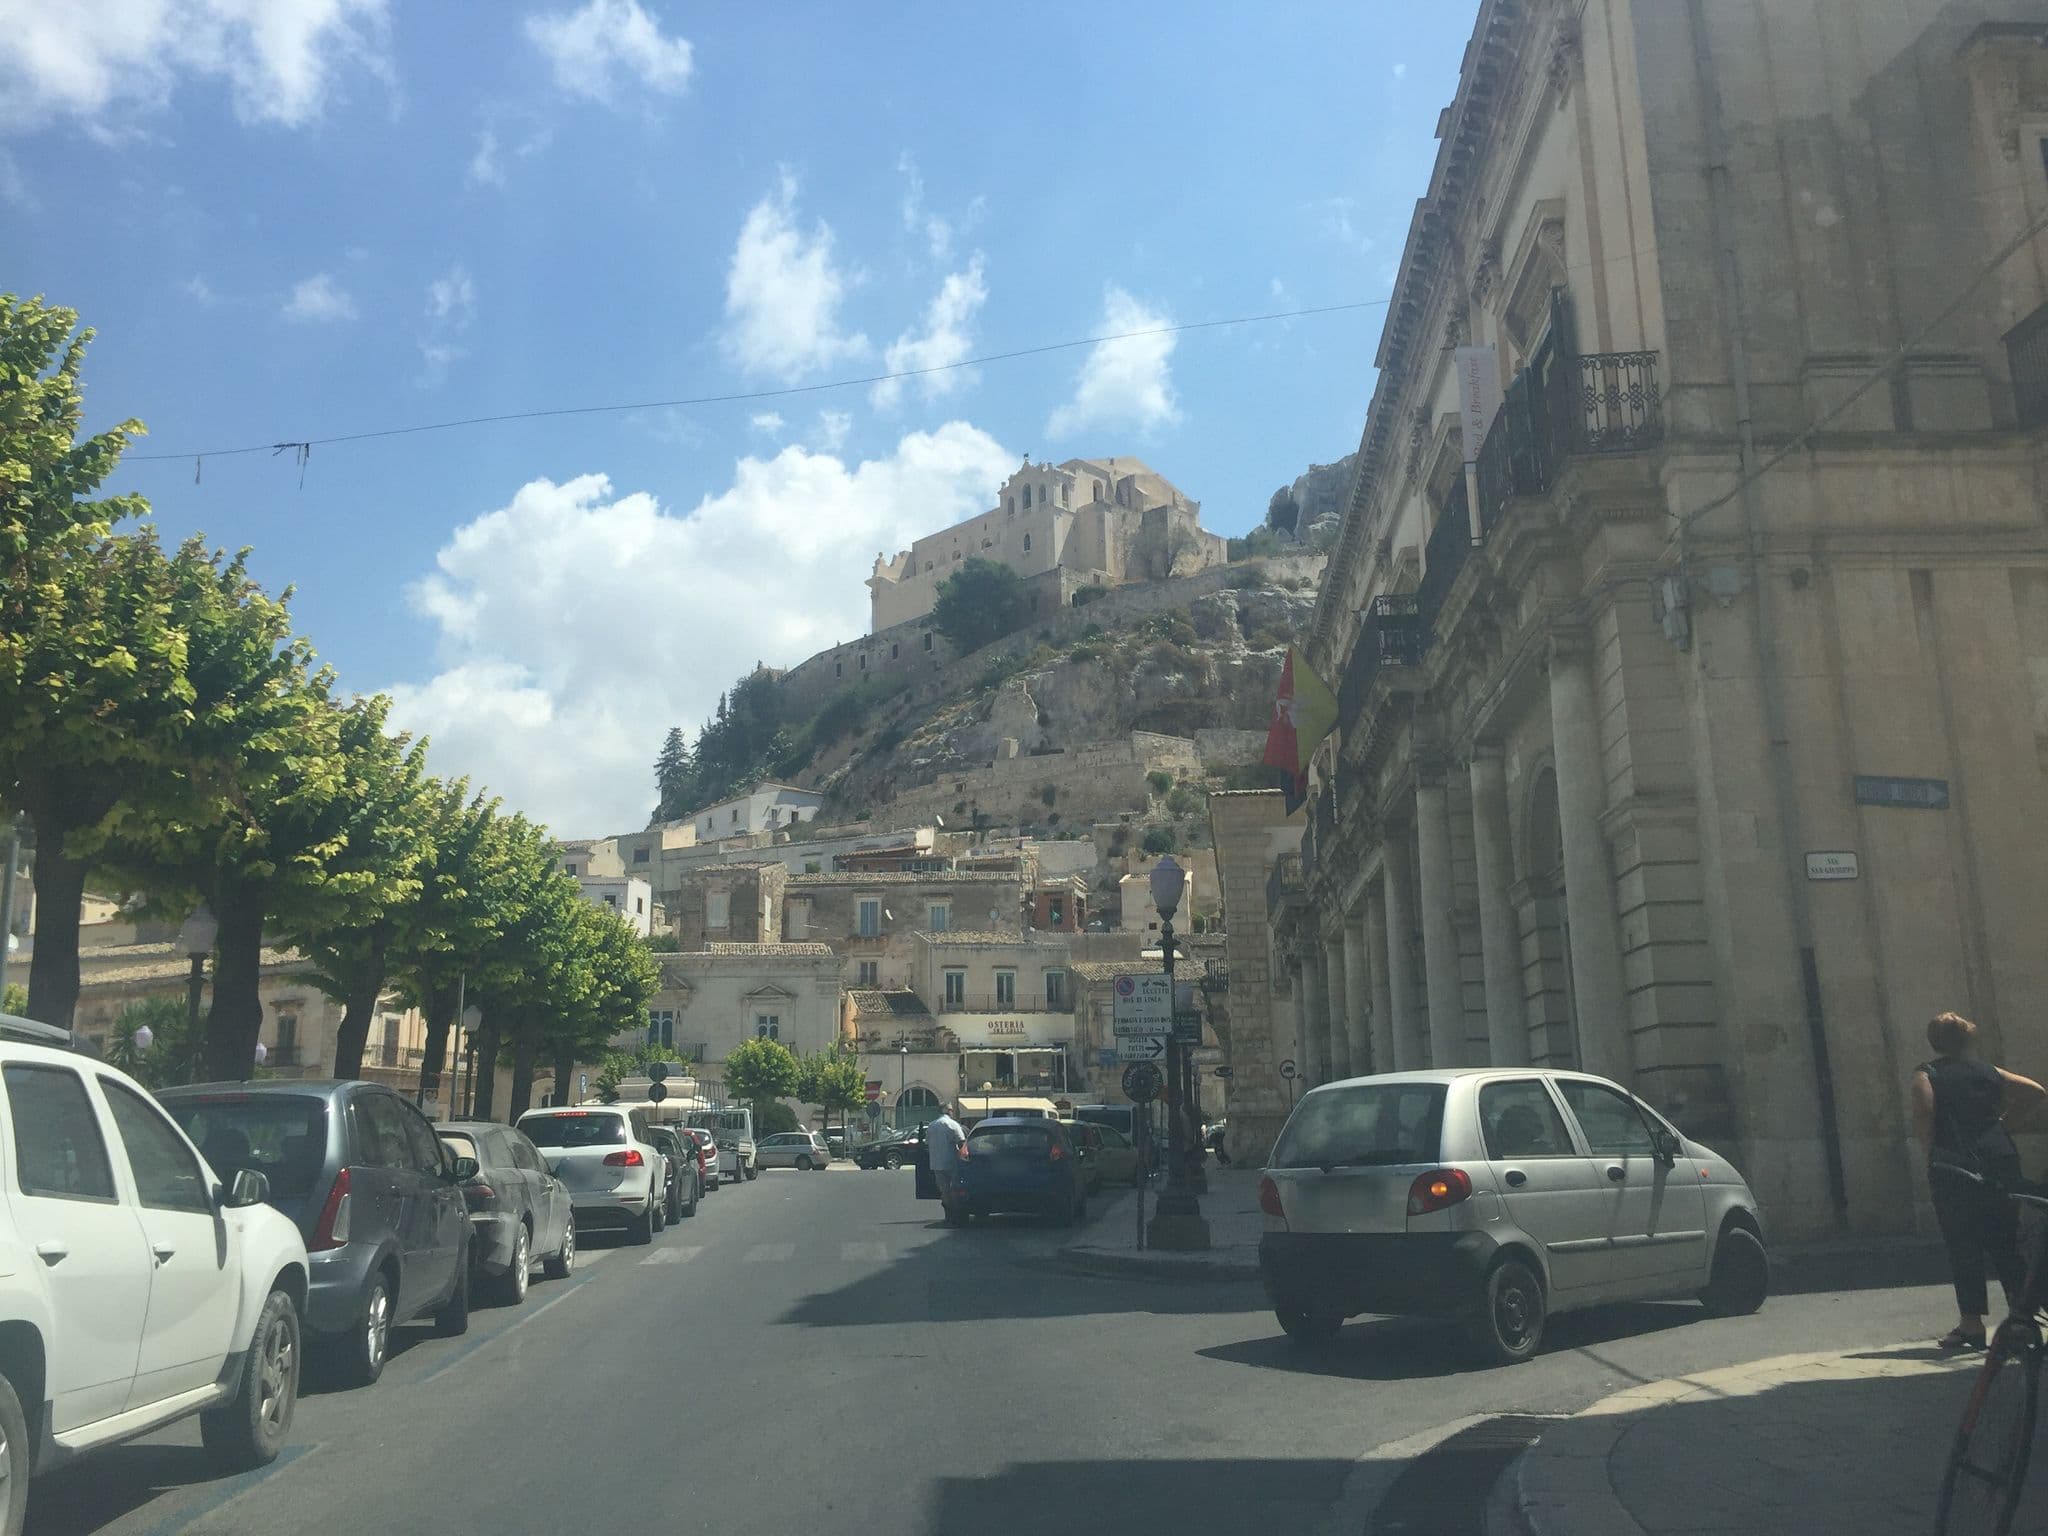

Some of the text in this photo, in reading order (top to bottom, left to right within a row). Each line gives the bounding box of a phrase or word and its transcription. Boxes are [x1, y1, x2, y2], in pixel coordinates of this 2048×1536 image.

[1468, 356, 1482, 414] Breakfast
[1472, 419, 1484, 430] &
[988, 1021, 1024, 1029] OSTERIA
